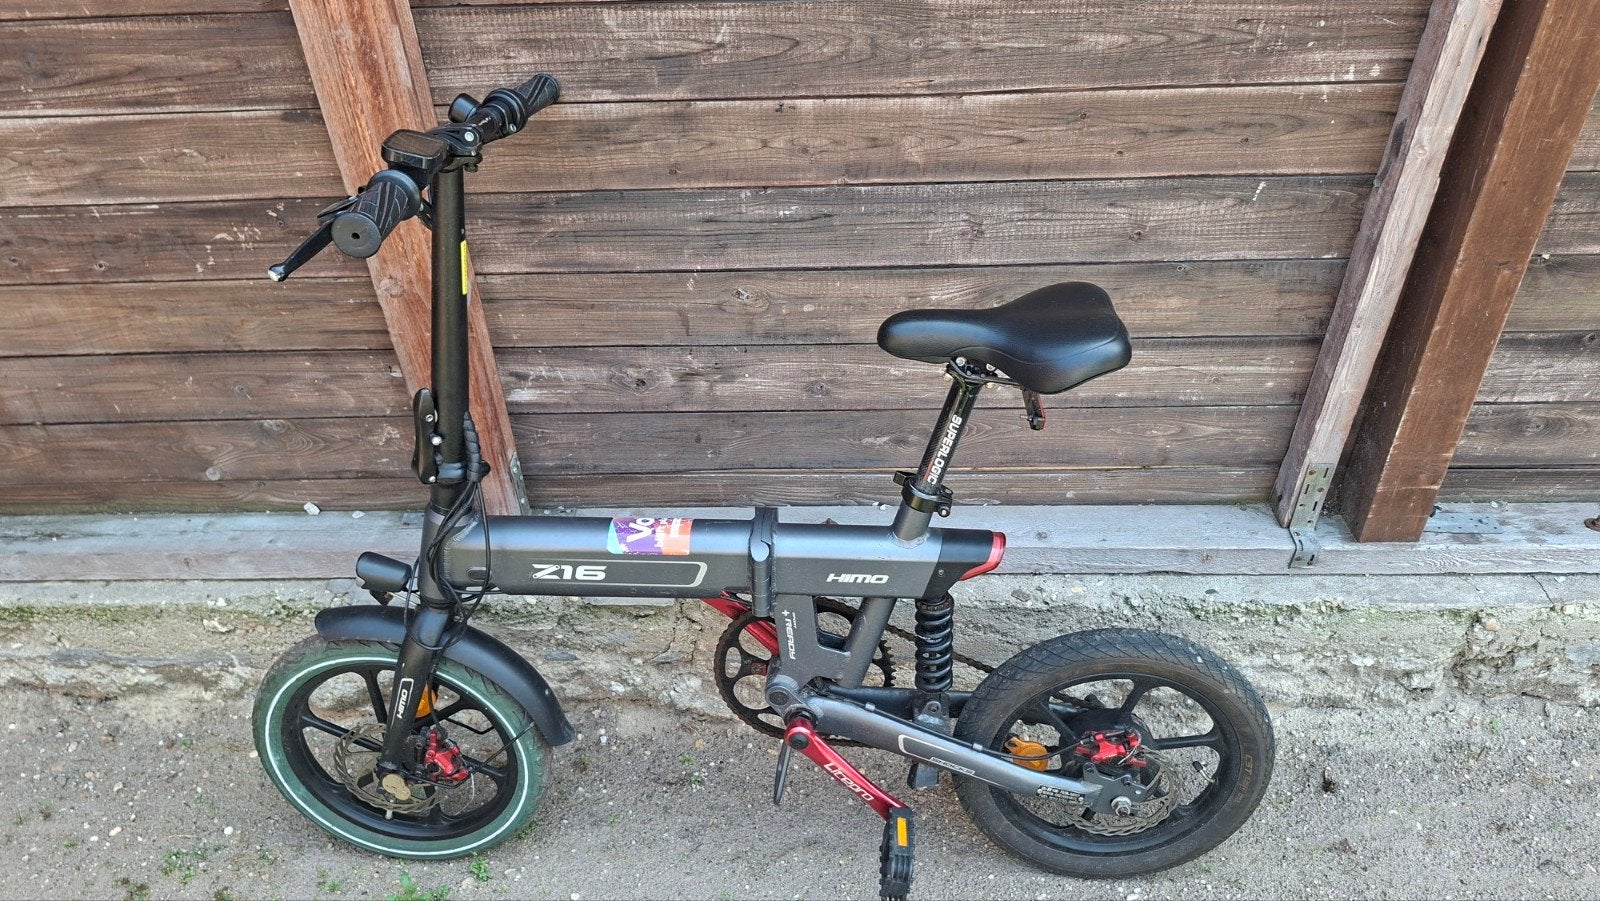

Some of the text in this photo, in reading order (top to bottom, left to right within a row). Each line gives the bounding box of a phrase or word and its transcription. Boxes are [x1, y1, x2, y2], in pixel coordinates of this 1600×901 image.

[927, 414, 962, 485] SUPERLOGIC
[531, 563, 607, 580] Z16
[826, 573, 890, 584] HIMO
[785, 618, 796, 660] READY
[397, 689, 408, 719] HIMO
